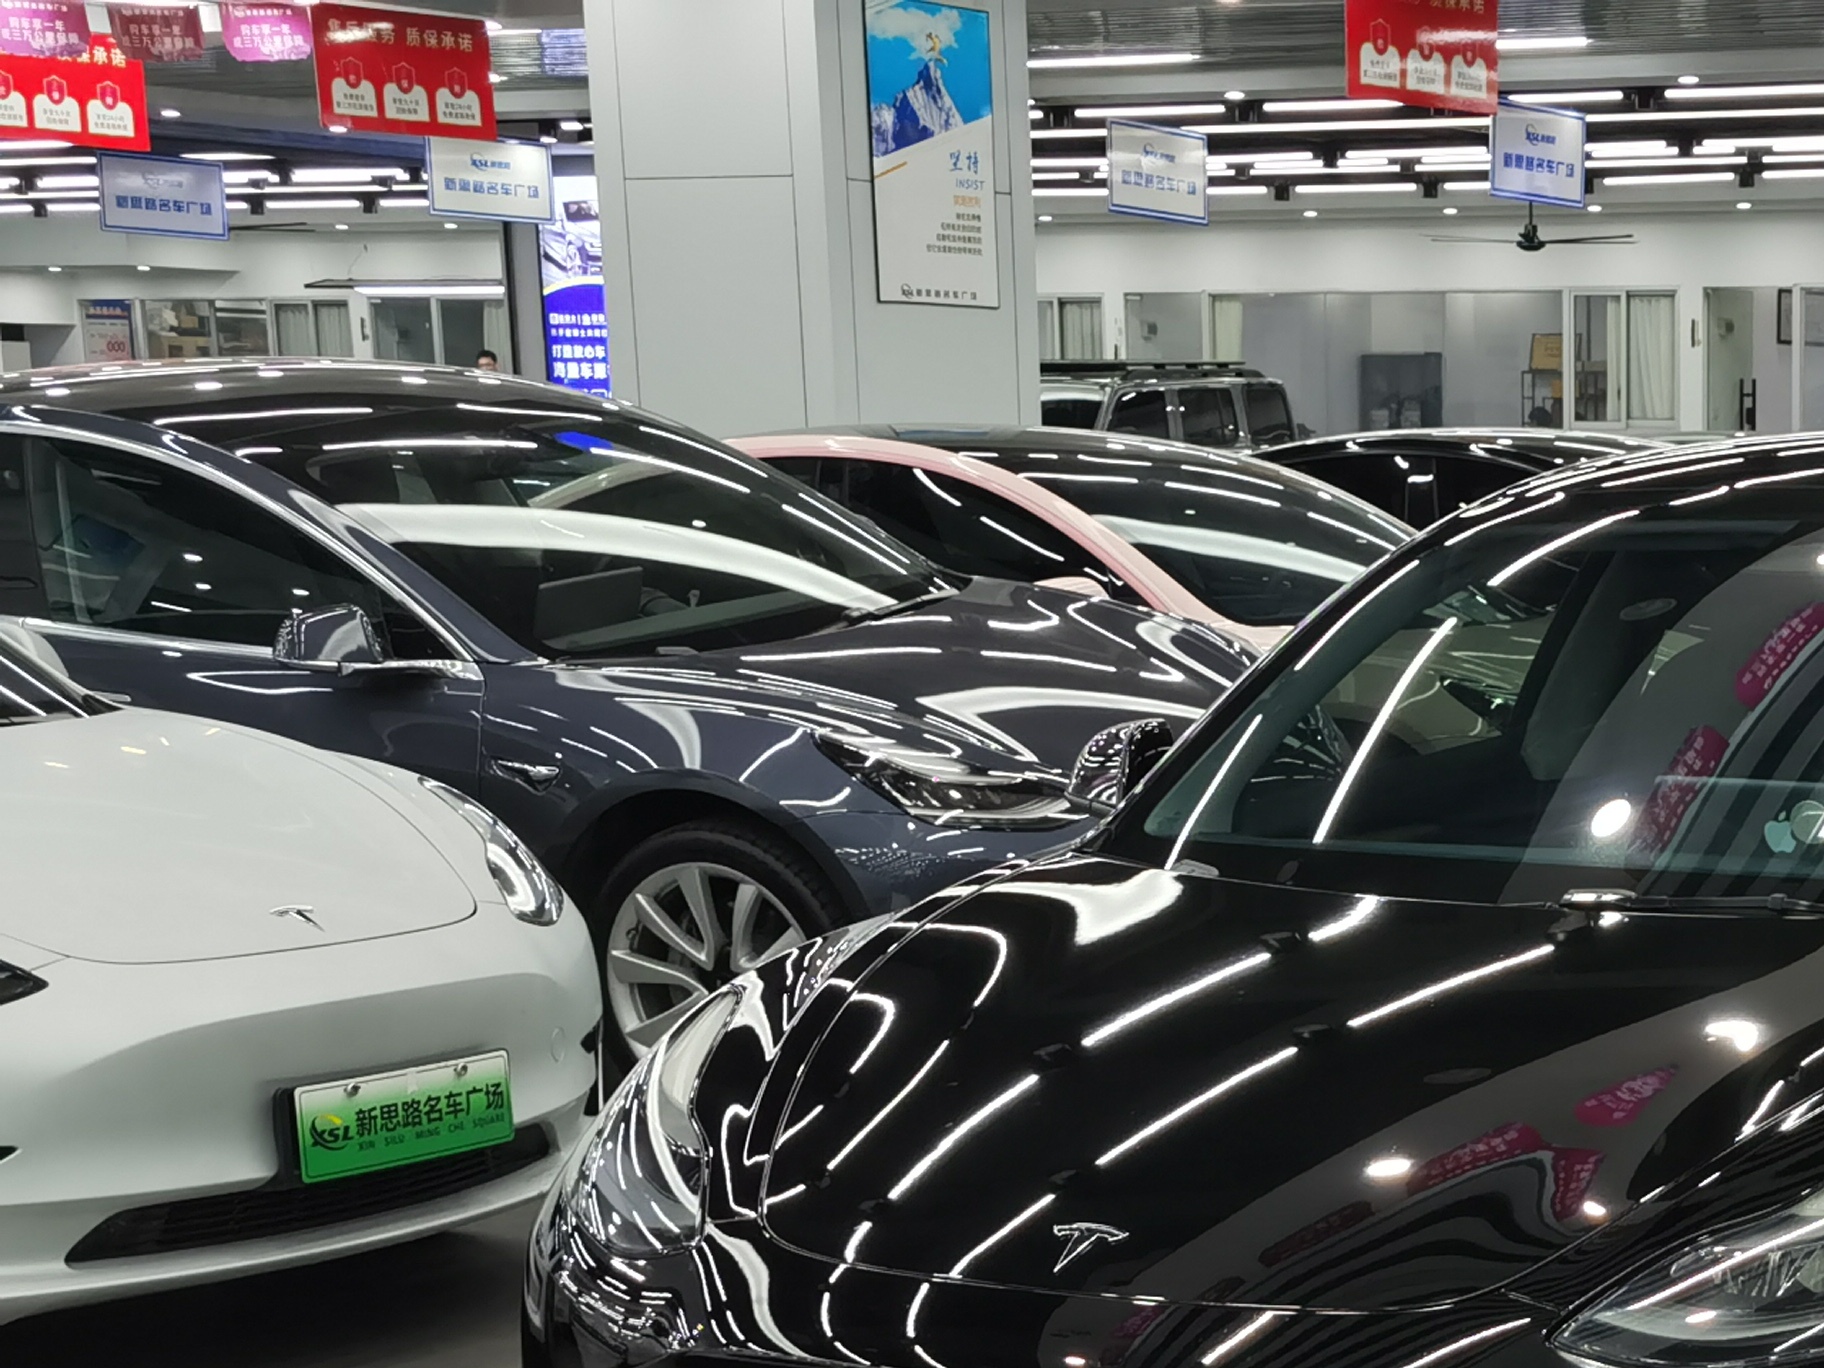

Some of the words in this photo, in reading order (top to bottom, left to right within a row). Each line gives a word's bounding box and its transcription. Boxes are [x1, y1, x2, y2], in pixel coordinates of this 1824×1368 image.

[405, 27, 473, 52] 质保承诺
[949, 150, 979, 174] 坚持
[955, 178, 985, 191] INSIST
[355, 1082, 505, 1138] 新思路名车广场
